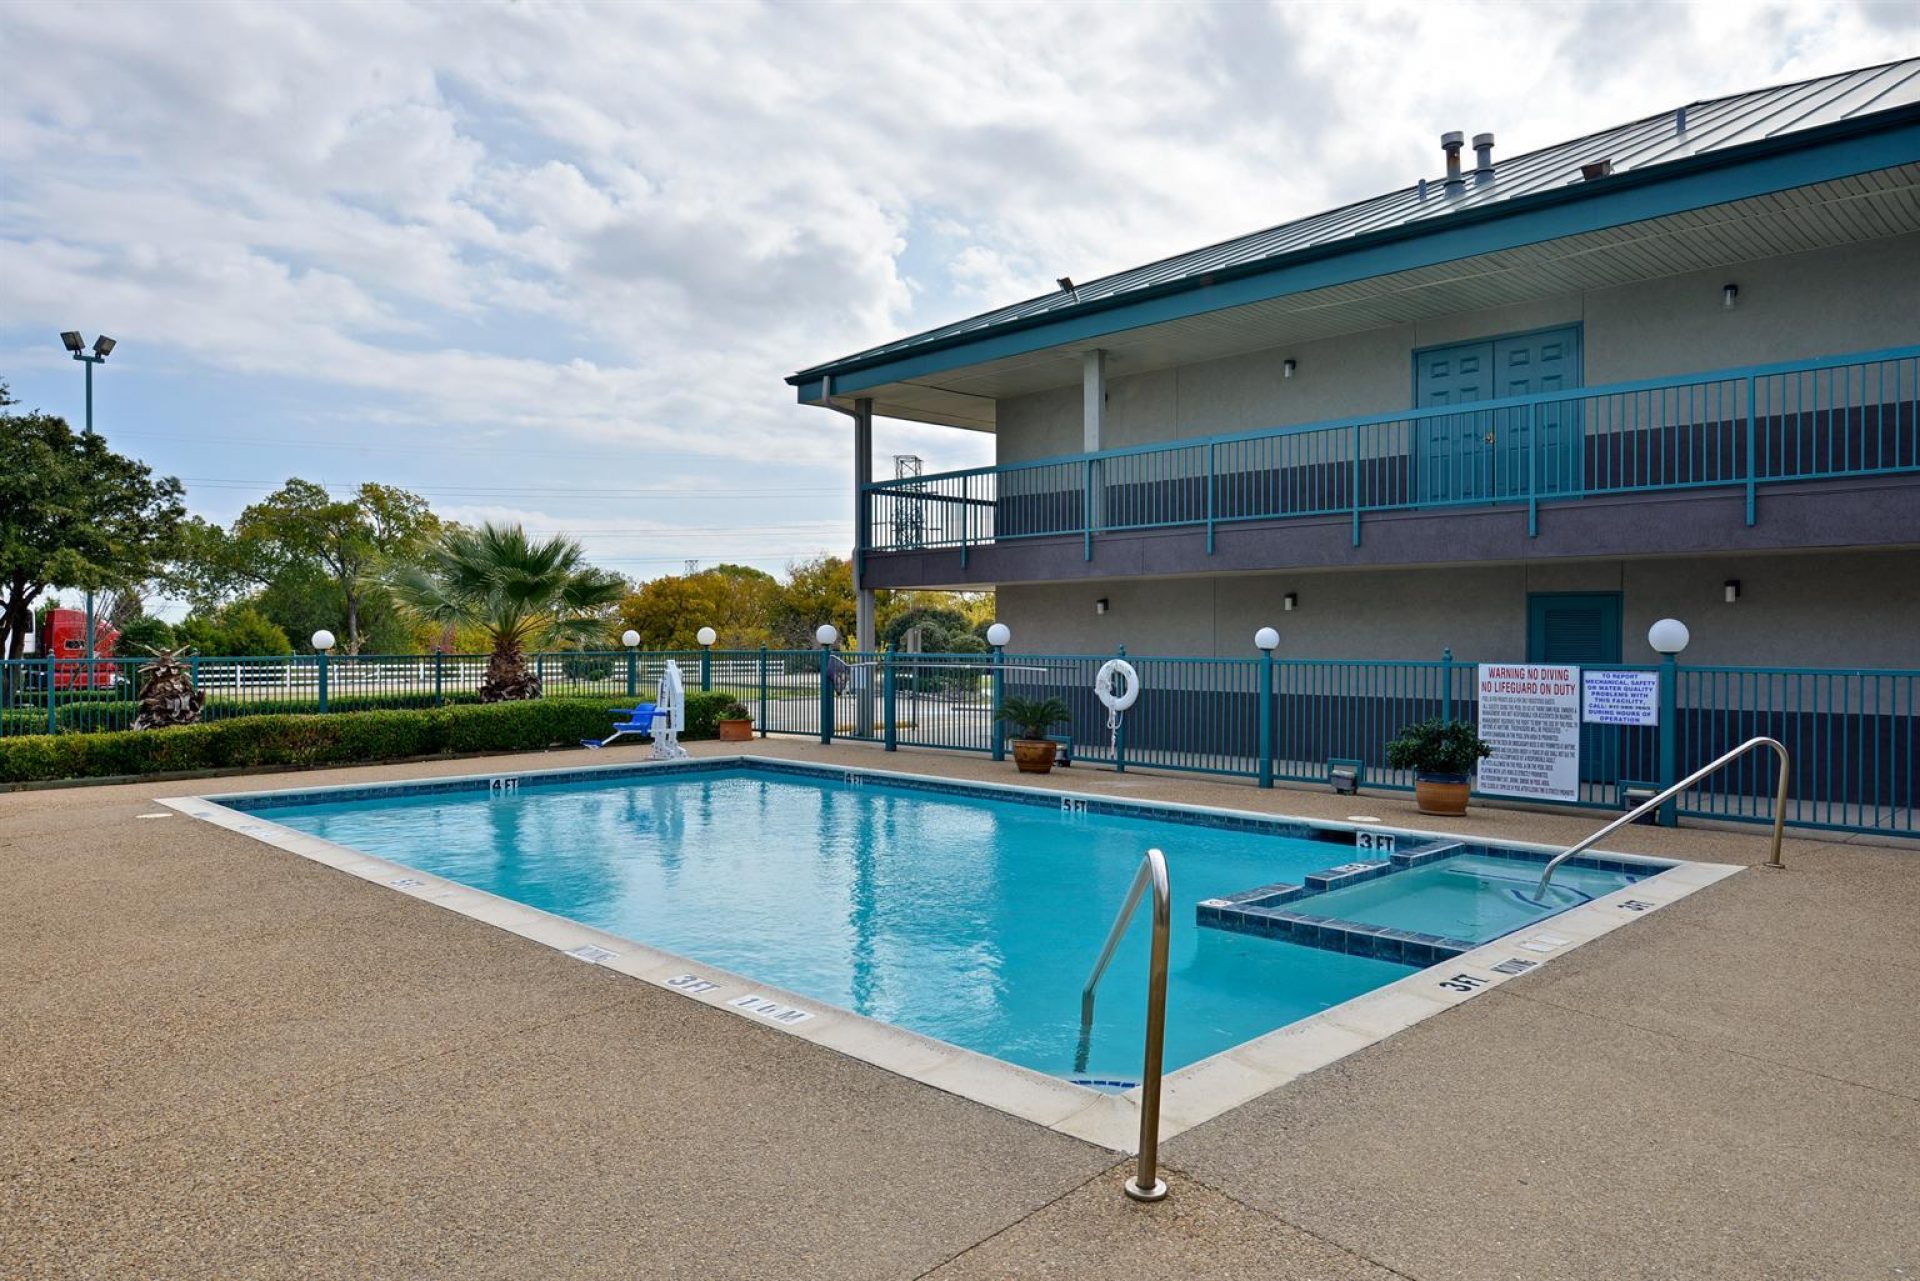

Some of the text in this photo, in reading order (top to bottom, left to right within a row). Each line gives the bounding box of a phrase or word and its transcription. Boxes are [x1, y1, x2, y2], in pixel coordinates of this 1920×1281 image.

[1488, 667, 1569, 680] WARNING NO DIVING
[1481, 681, 1576, 696] NO LIFEGUARD ON DUTY
[492, 778, 517, 790] 4 FT
[1063, 798, 1086, 812] 5 FT
[1360, 833, 1394, 851] 3 FT
